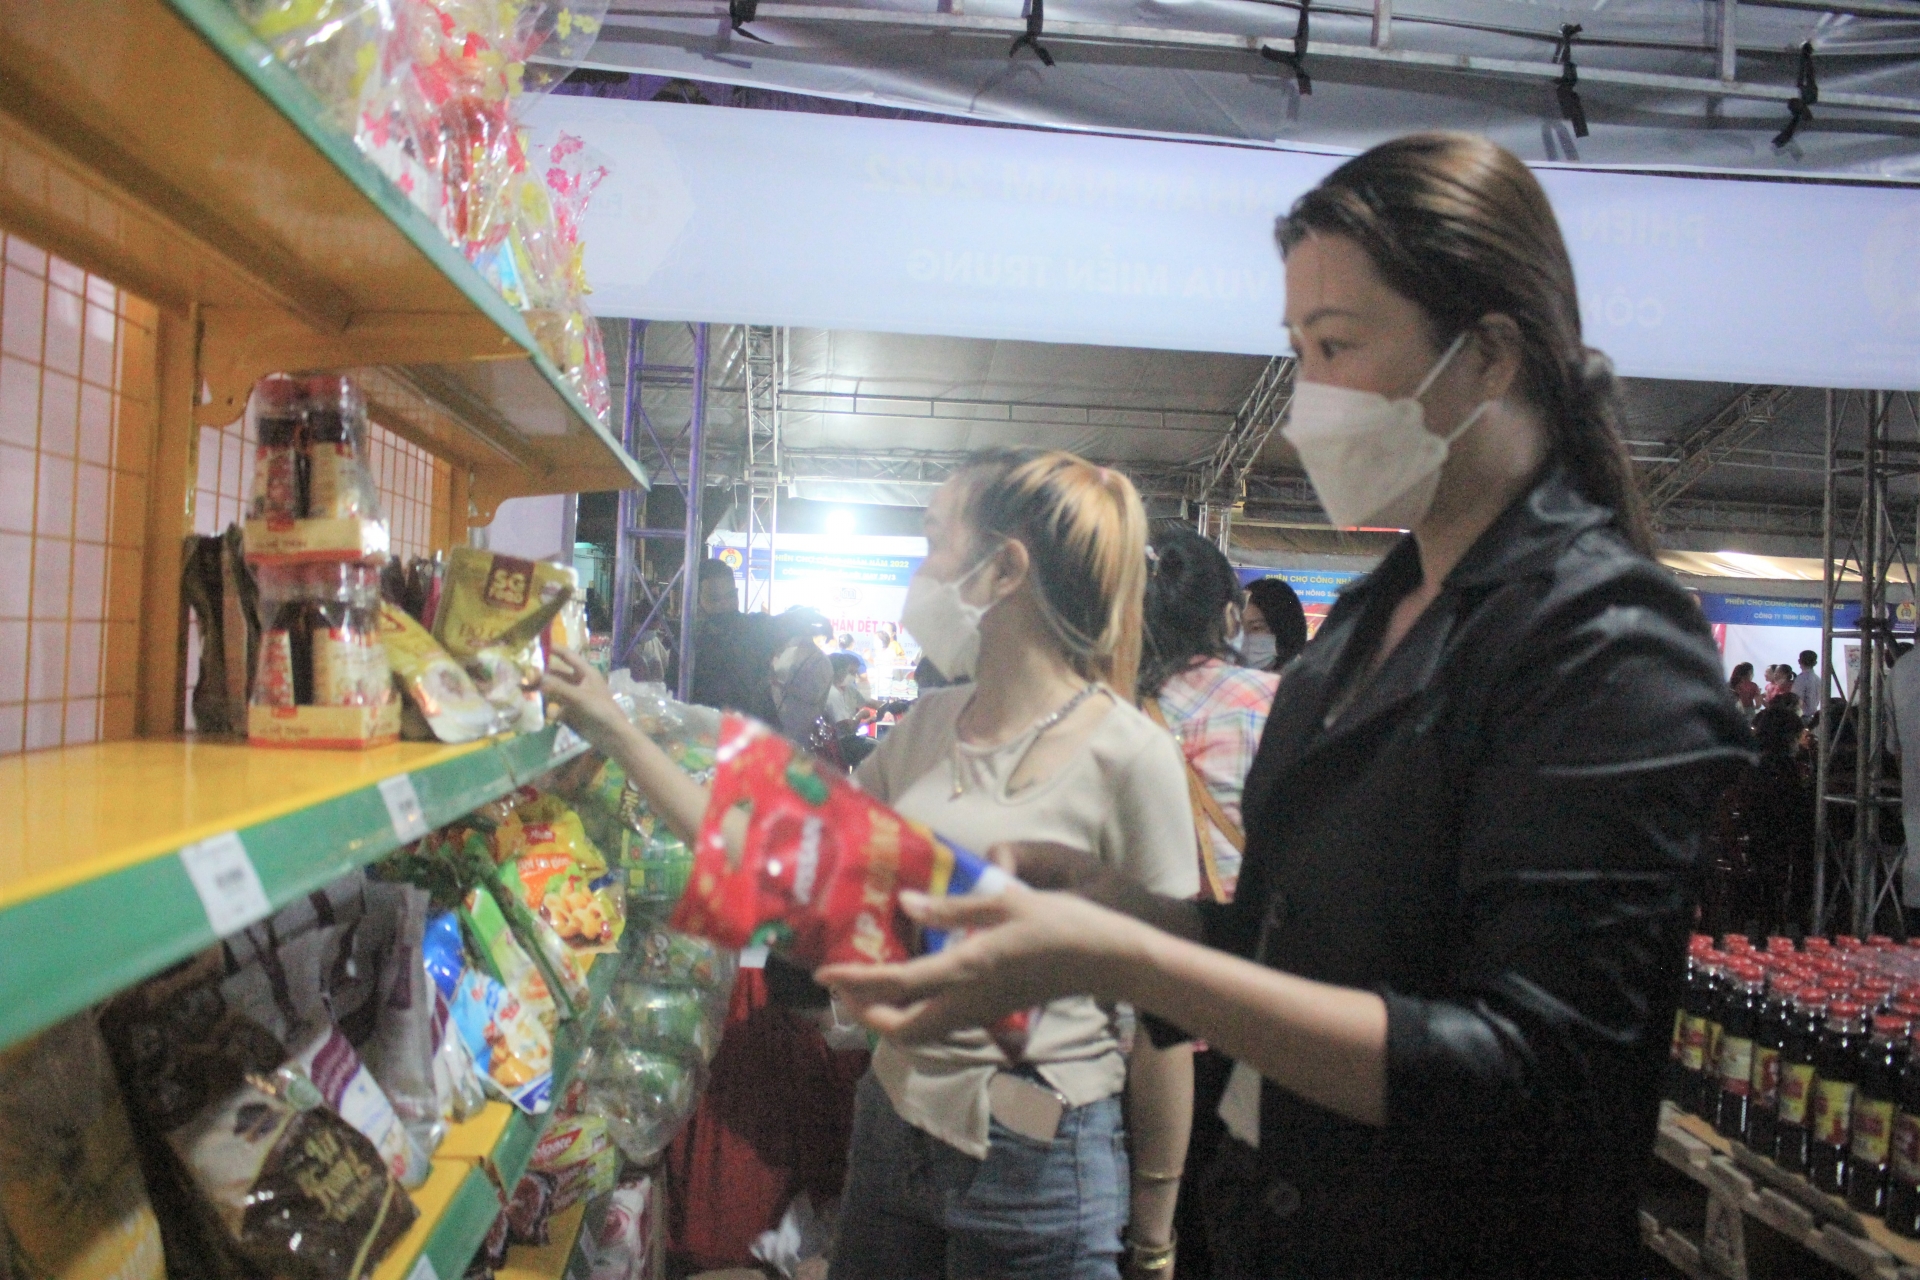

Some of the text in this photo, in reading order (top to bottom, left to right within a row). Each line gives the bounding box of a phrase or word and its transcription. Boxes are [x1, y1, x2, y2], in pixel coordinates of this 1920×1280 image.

[774, 553, 794, 562] HIÊN
[890, 560, 909, 568] 2022
[1290, 575, 1308, 585] CHỢ
[1310, 575, 1334, 583] CÔNG
[1305, 588, 1326, 597] NÔNG
[1753, 612, 1773, 620] CÔNG
[857, 616, 878, 637] DỆT
